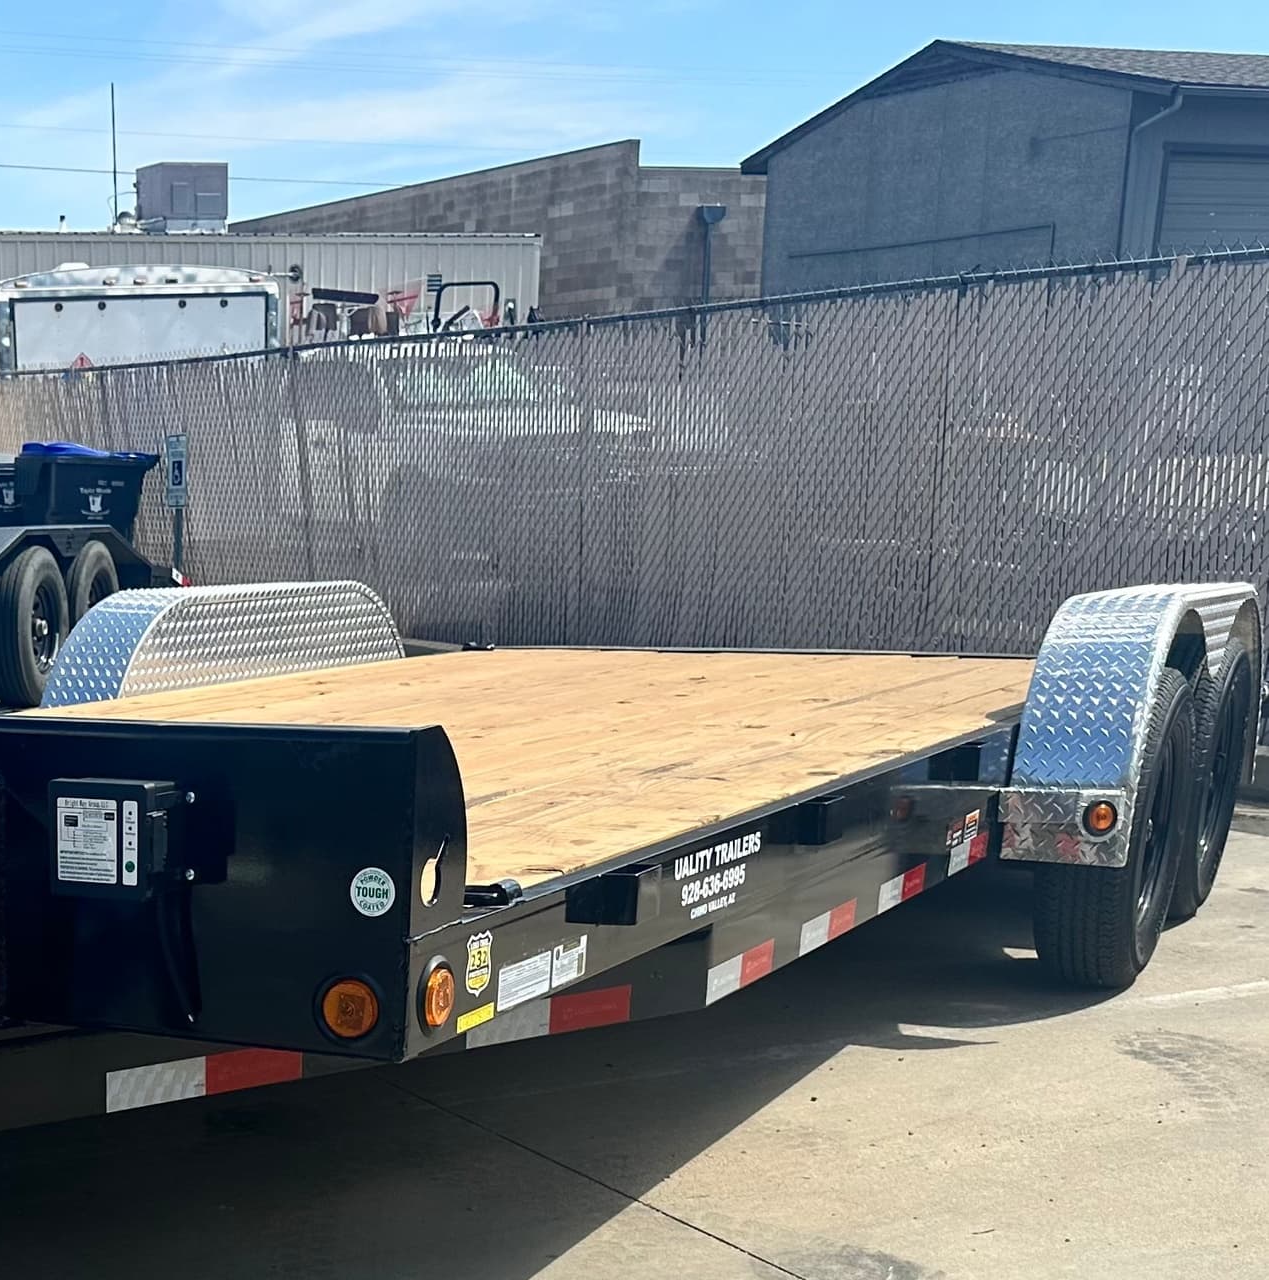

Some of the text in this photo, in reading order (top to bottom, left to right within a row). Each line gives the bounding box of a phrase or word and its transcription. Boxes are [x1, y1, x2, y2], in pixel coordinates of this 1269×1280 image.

[675, 831, 761, 880] UALITY TRAILERS
[360, 874, 386, 886] POWDER
[681, 863, 746, 906] 928-636-6995
[356, 886, 389, 899] TOUGH
[360, 900, 385, 911] COATED
[471, 950, 487, 968] 232
